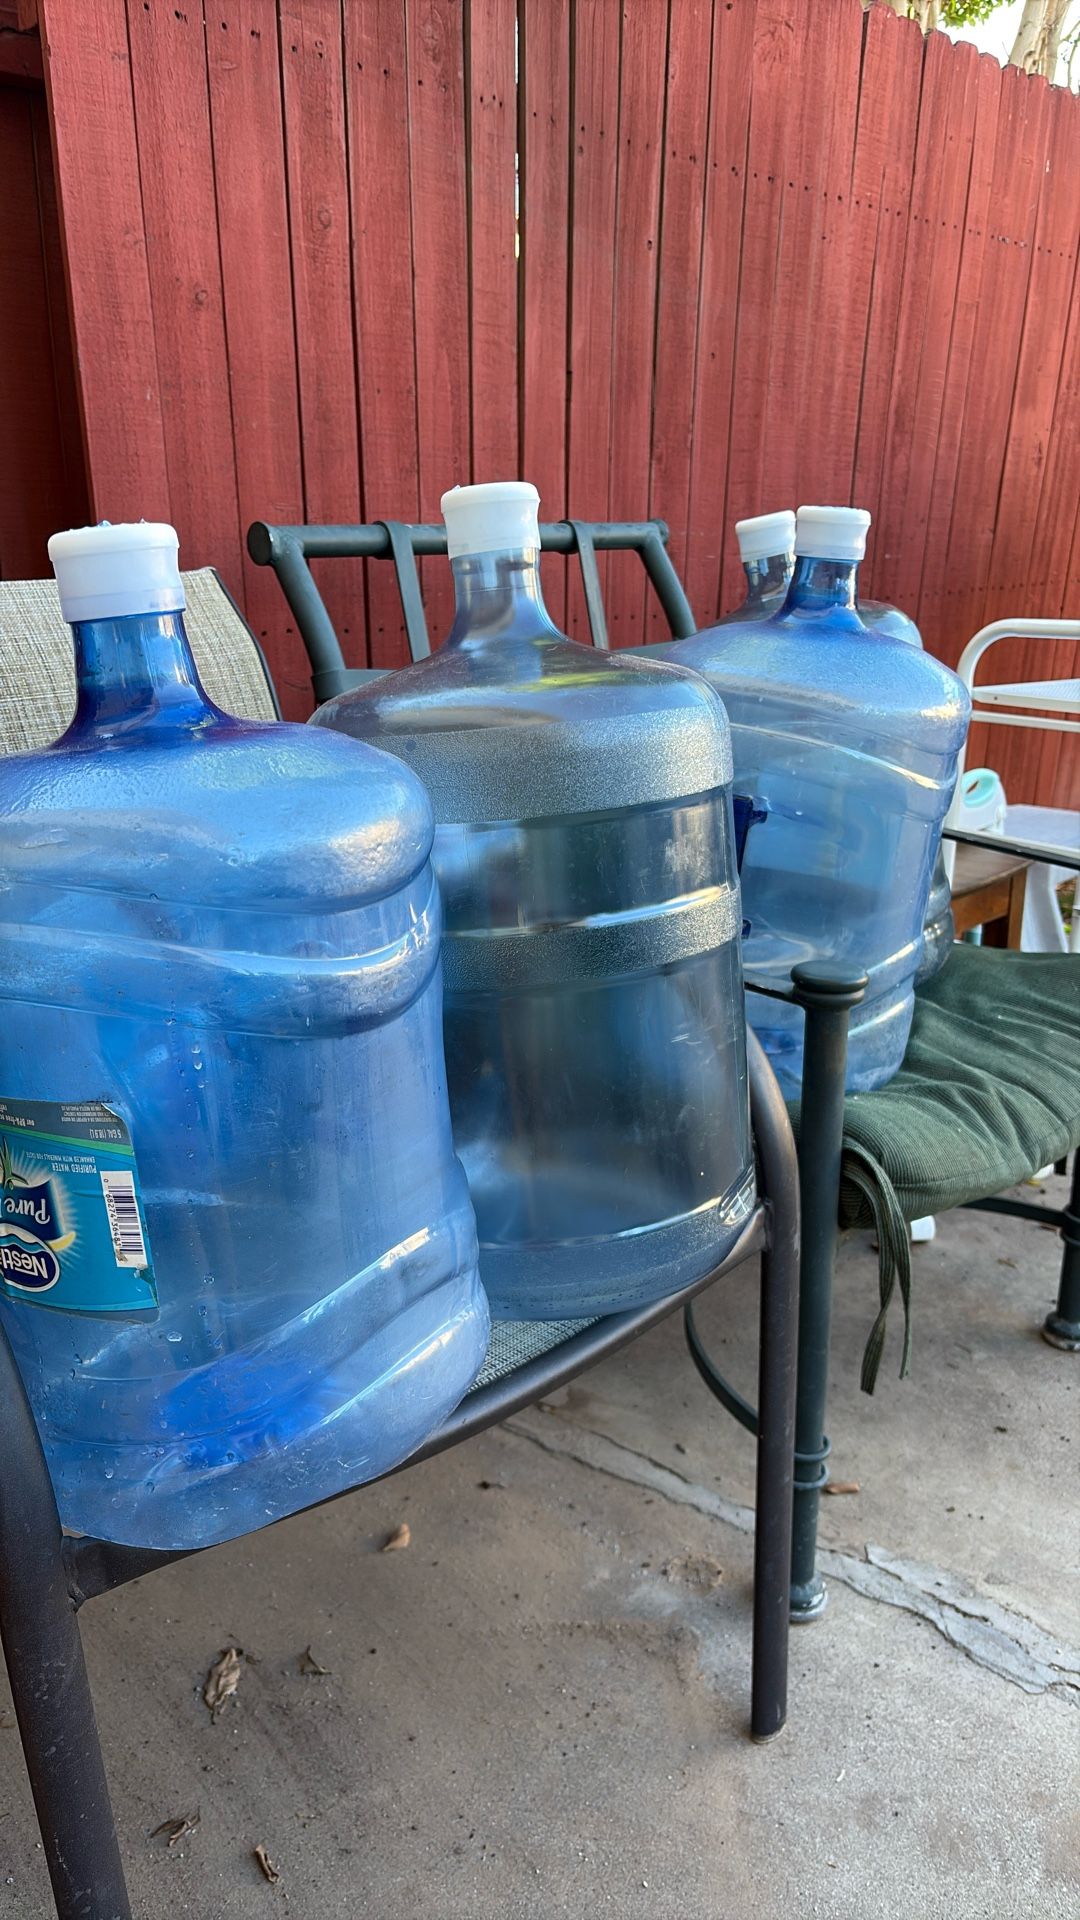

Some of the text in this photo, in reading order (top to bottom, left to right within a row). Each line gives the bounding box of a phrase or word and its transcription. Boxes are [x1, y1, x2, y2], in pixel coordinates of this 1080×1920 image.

[51, 1162, 97, 1174] PURIFIED WATER
[3, 1197, 51, 1225] Pure
